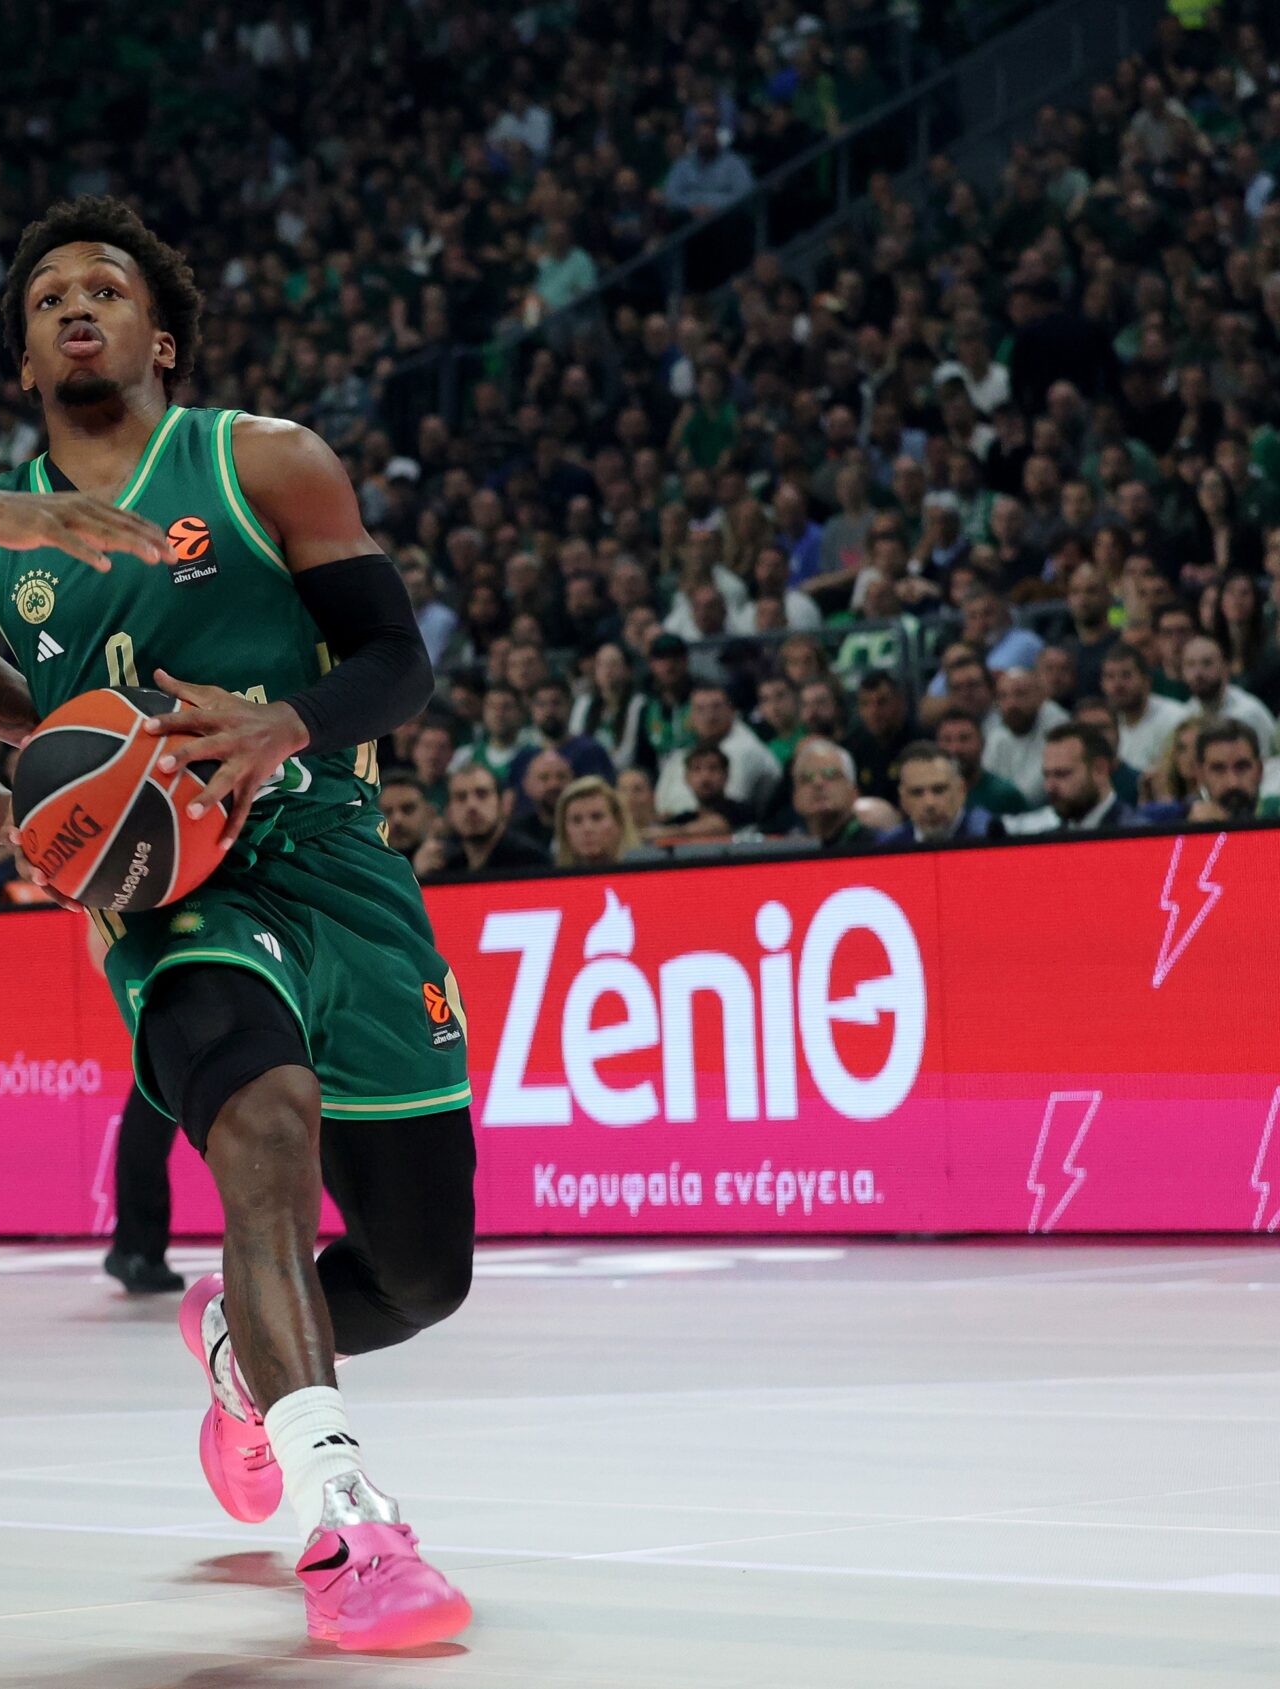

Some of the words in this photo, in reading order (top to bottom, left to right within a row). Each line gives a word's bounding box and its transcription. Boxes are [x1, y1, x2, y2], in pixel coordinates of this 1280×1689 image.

[174, 573, 191, 584] abu
[191, 565, 218, 579] dhabi
[534, 1161, 703, 1218] Κορυφαία
